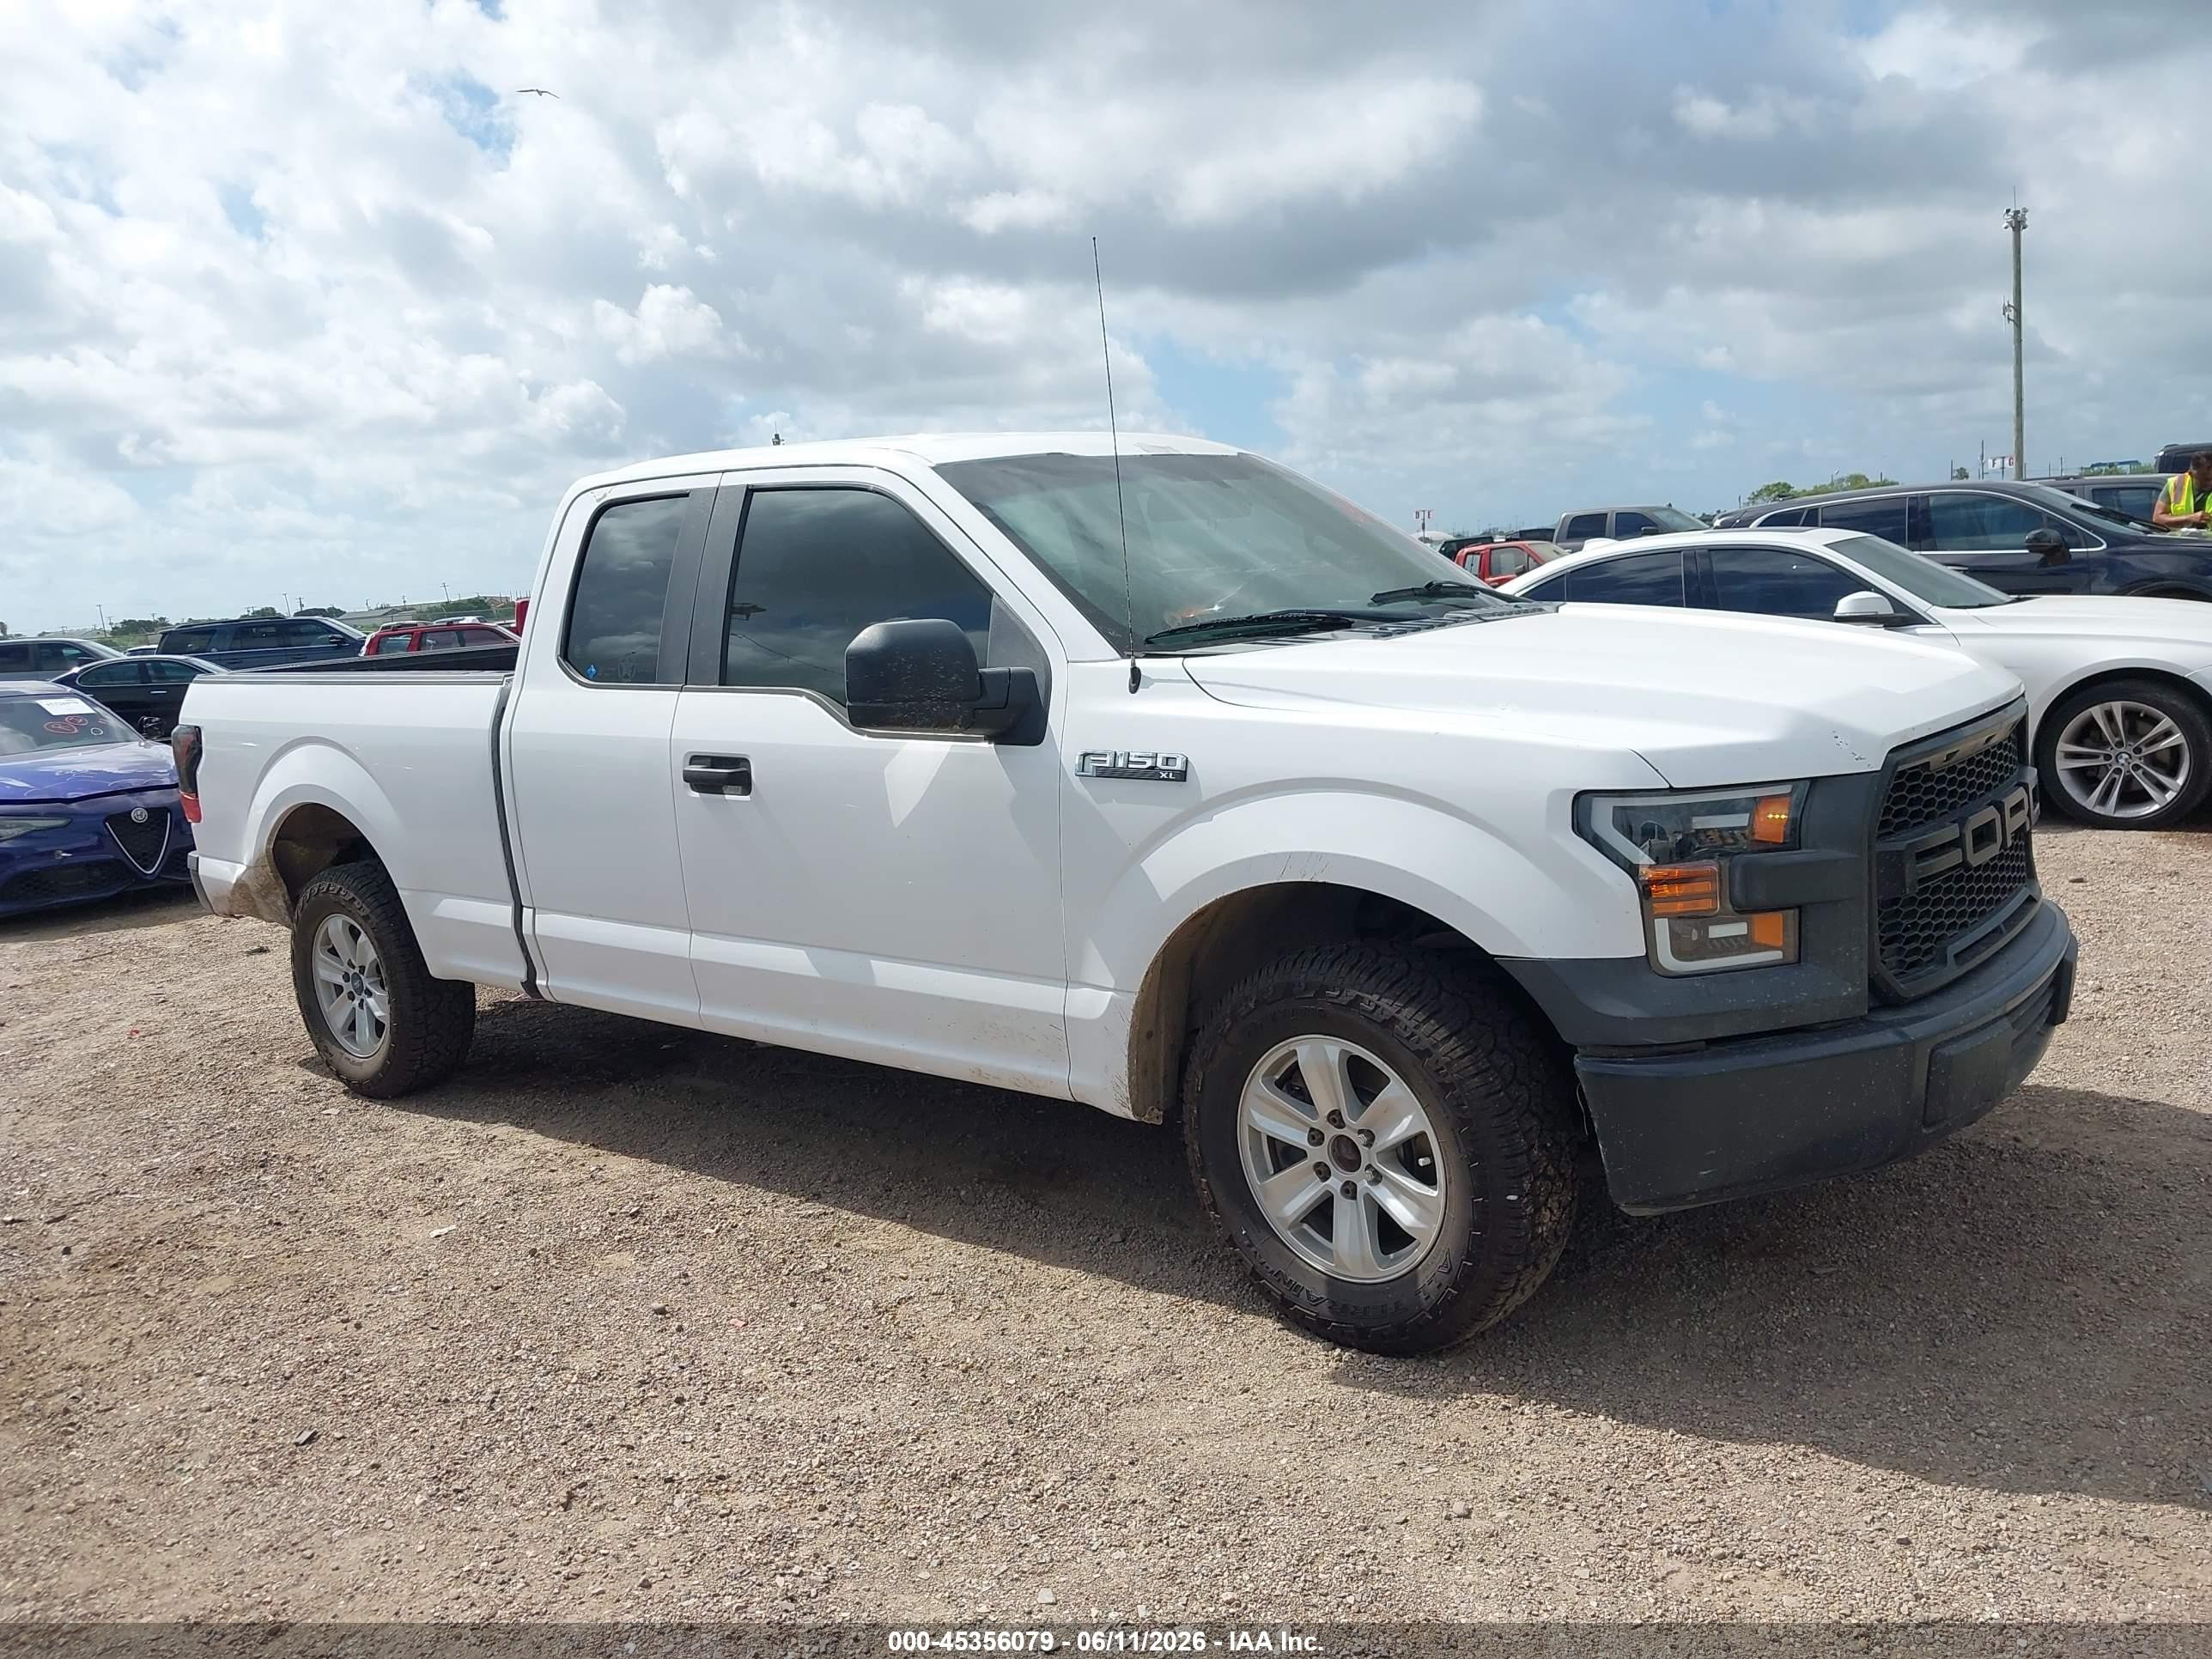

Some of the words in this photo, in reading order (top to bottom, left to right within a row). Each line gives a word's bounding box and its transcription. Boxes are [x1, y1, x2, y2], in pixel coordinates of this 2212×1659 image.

[1074, 750, 1188, 776] F150
[1159, 771, 1176, 780] XL
[1271, 1268, 1408, 1321] TERRAIN
